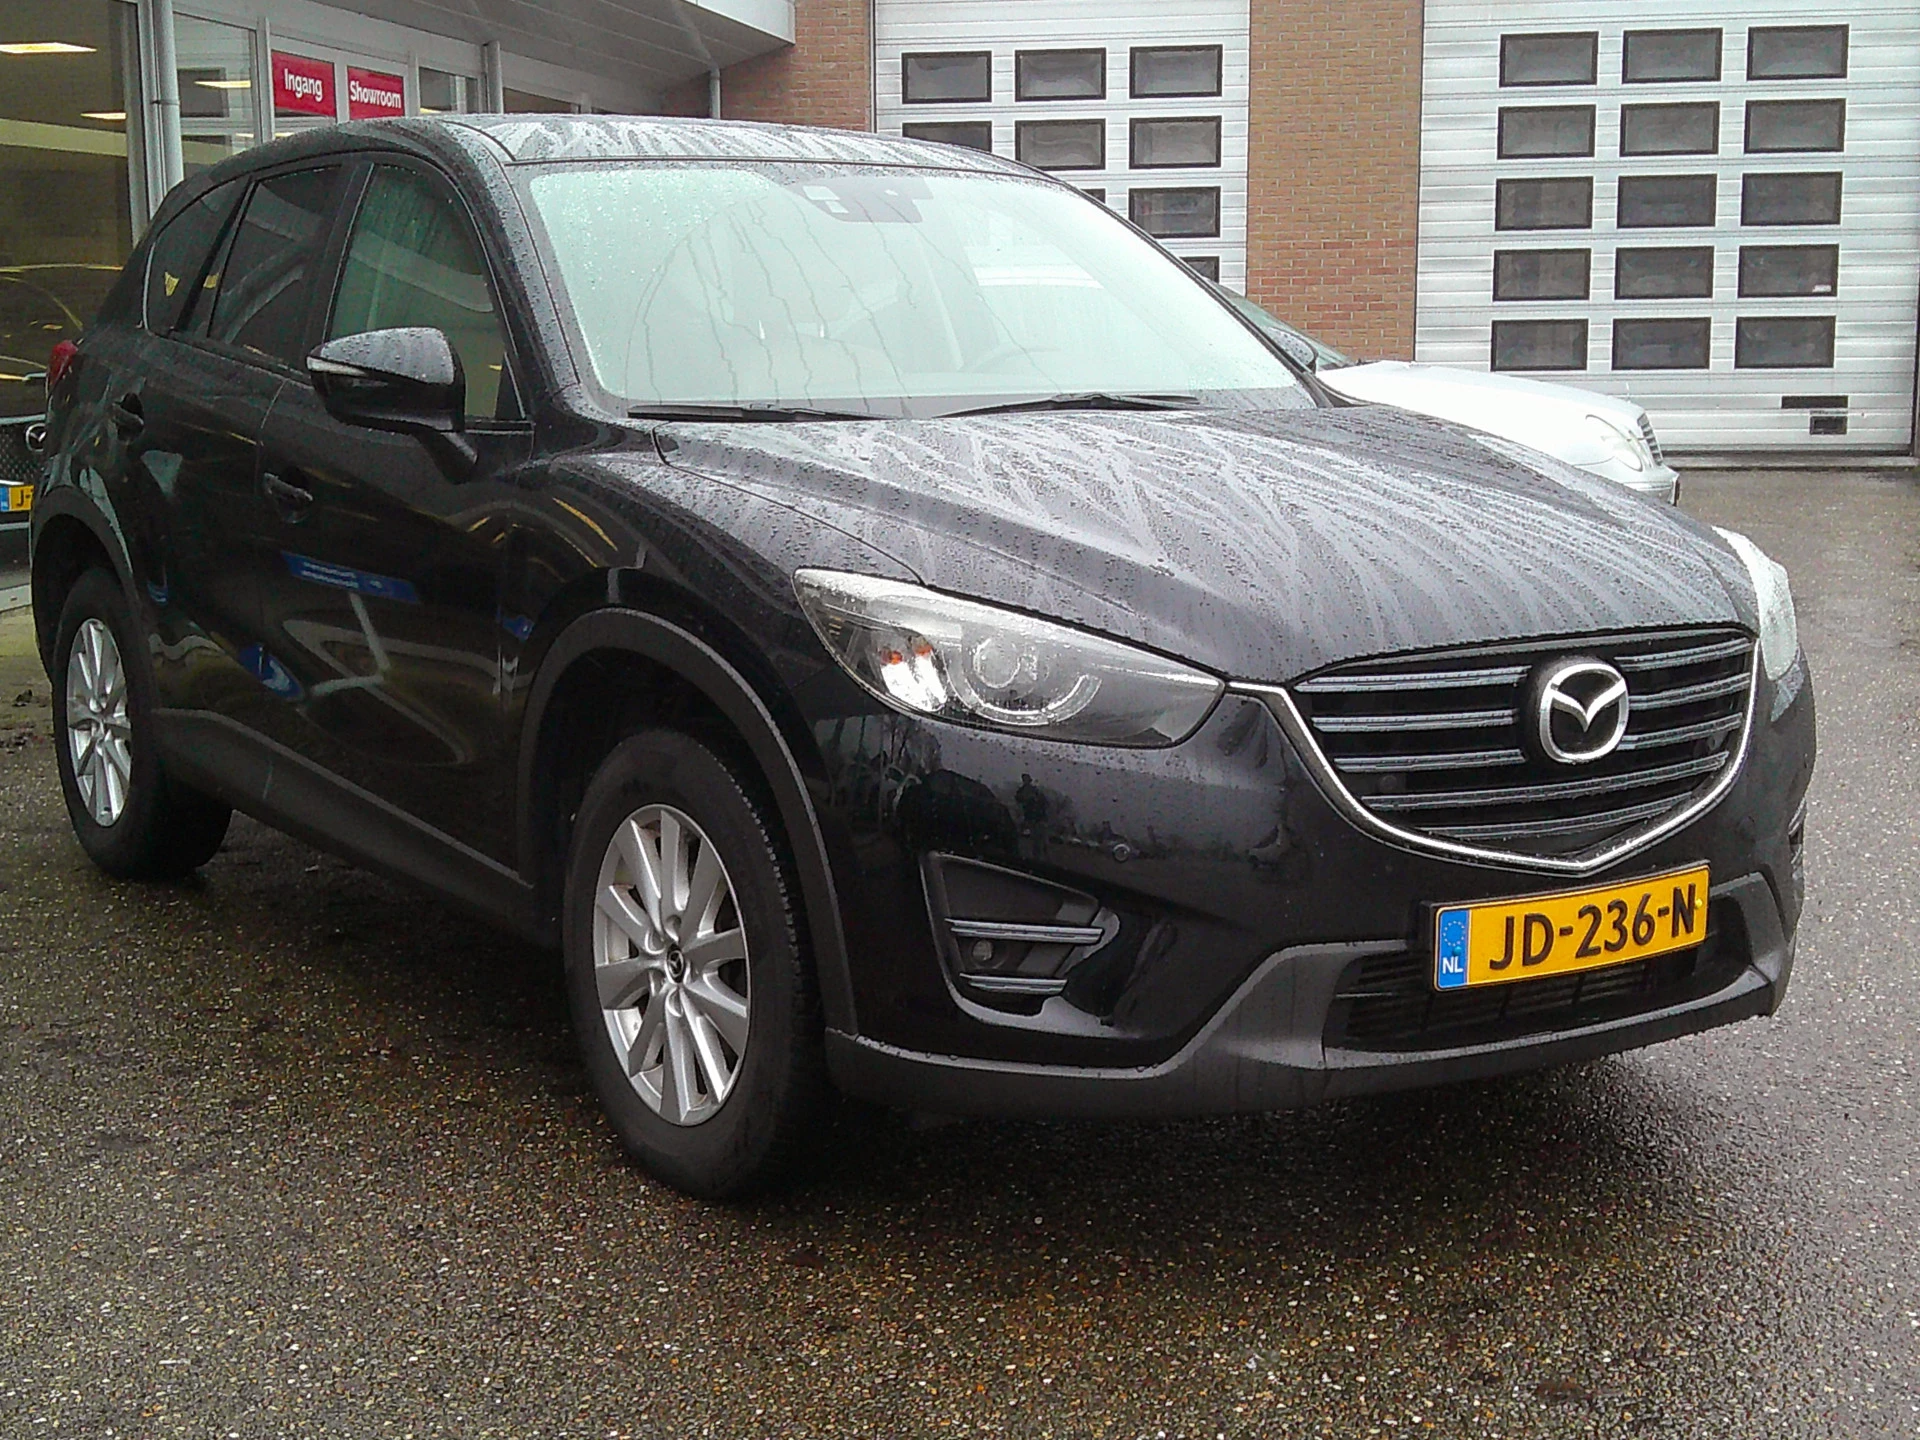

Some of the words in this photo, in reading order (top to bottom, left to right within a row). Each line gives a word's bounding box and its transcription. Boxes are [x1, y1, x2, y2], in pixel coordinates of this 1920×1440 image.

[284, 68, 323, 102] Ingang
[350, 80, 402, 109] Showroom
[16, 487, 33, 507] J-
[1488, 882, 1697, 971] JD-236-N
[1442, 956, 1464, 974] NL
